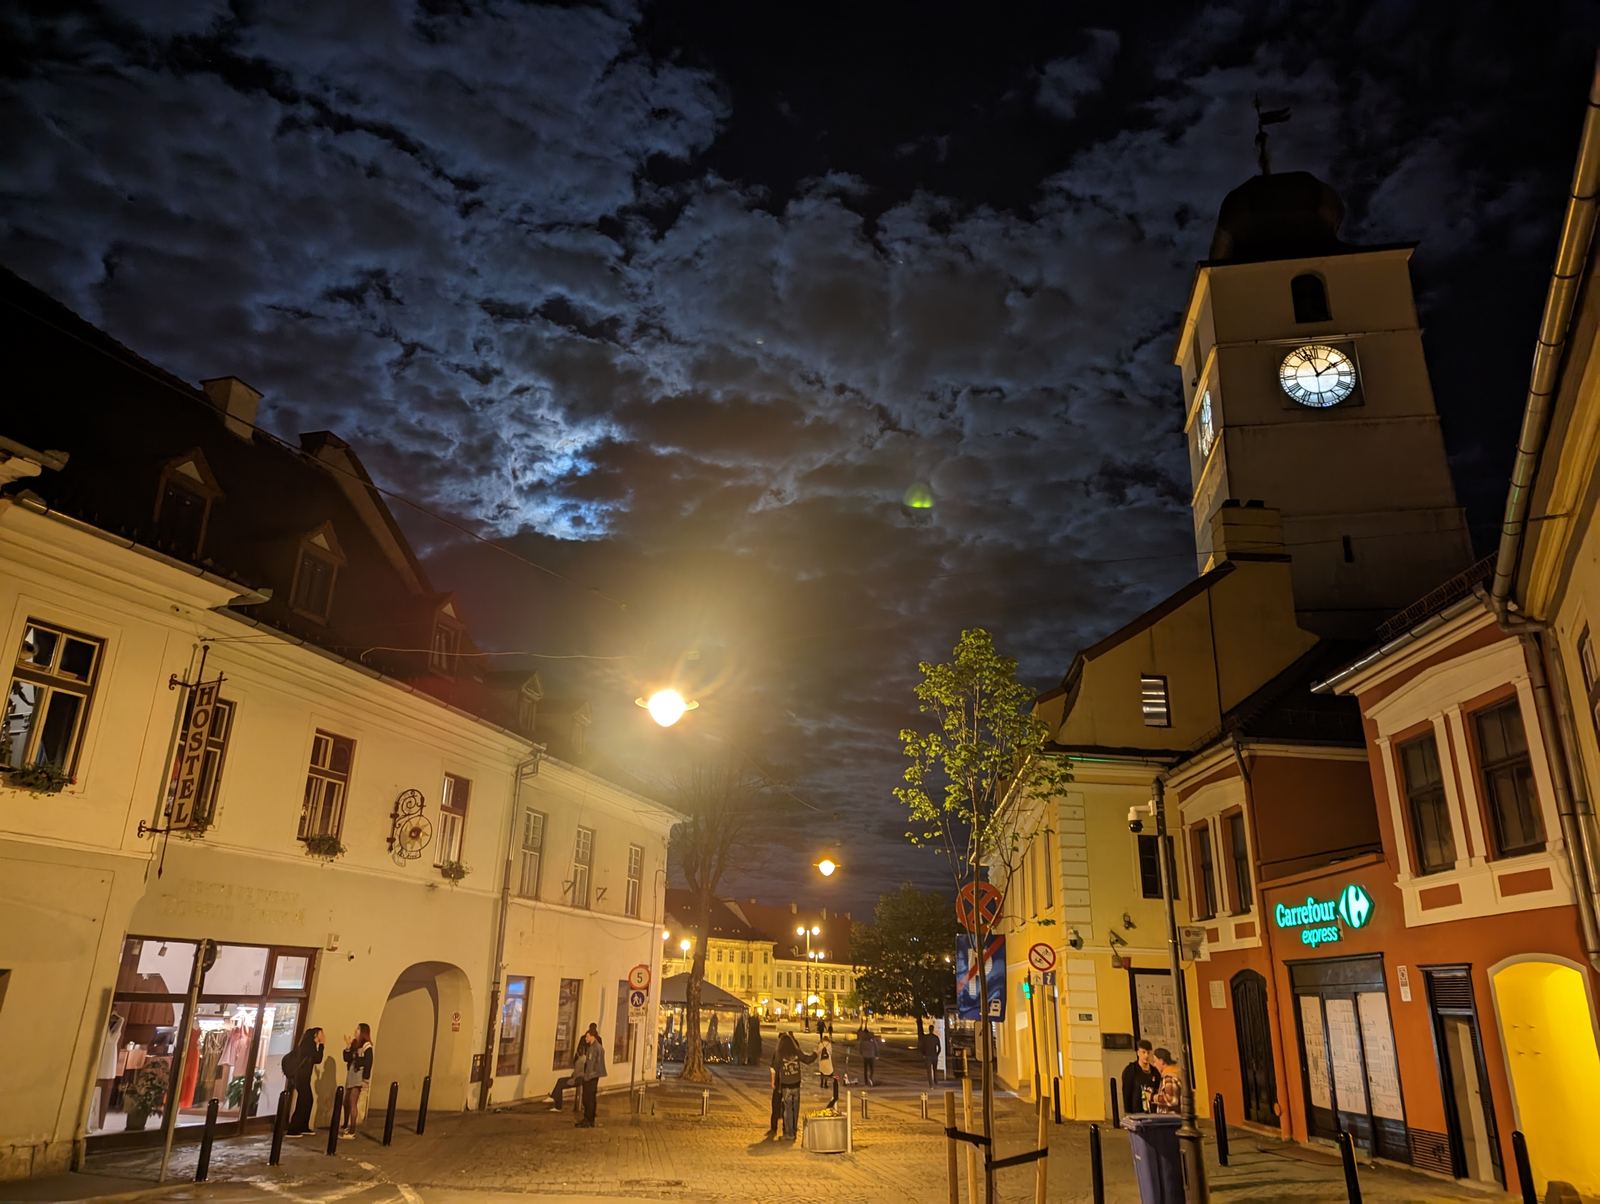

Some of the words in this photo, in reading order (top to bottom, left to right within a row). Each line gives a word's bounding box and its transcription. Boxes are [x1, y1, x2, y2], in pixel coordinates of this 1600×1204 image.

[174, 685, 216, 824] HOSTEL
[1275, 896, 1336, 928] Carrefour
[1301, 926, 1339, 948] express
[636, 972, 643, 984] 5
